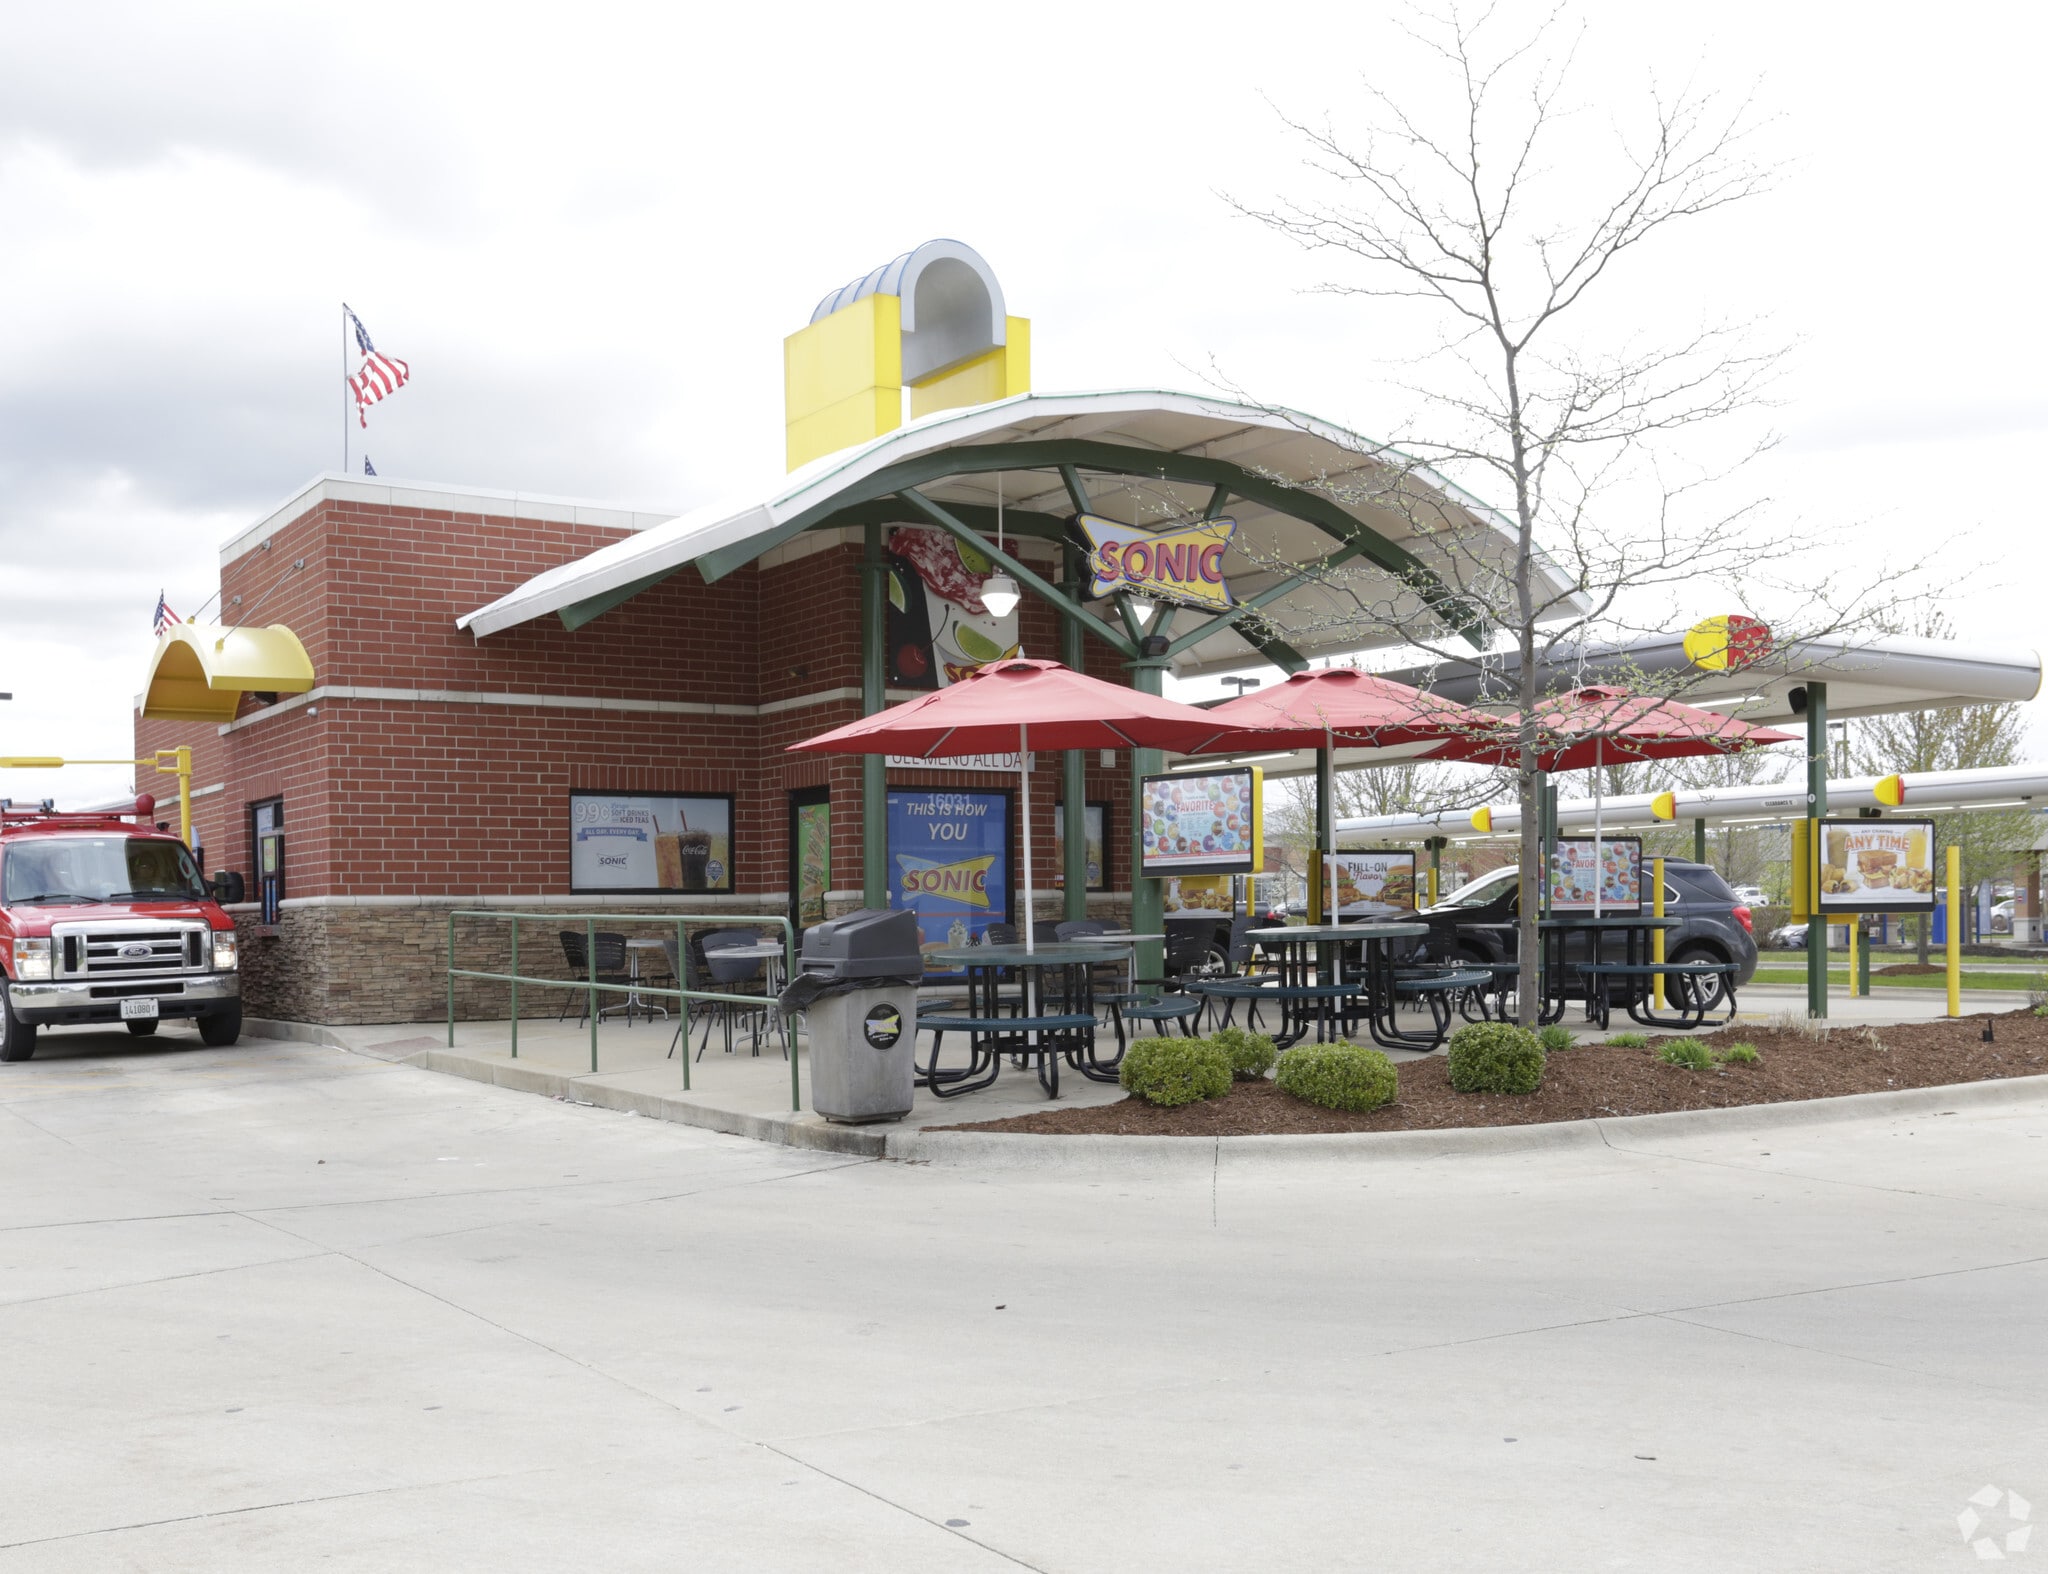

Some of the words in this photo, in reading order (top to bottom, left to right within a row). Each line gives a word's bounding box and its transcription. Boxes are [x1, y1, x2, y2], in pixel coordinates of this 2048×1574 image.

[1097, 540, 1226, 584] SONIC
[973, 752, 999, 768] ALL
[927, 793, 970, 809] 16031
[575, 801, 610, 823] 99¢
[611, 809, 626, 817] SOFT
[627, 809, 650, 817] DRINKS
[906, 802, 936, 816] THIS
[939, 803, 952, 816] IS
[955, 803, 988, 817] HOW
[635, 816, 650, 824] TEAS
[928, 822, 968, 841] YOU
[1844, 835, 1873, 850] ANY
[1877, 834, 1911, 850] TIME
[599, 857, 627, 865] SONIC
[1347, 862, 1388, 872] FULL-ON
[1572, 860, 1608, 868] FAVORE
[906, 869, 987, 892] SONIC
